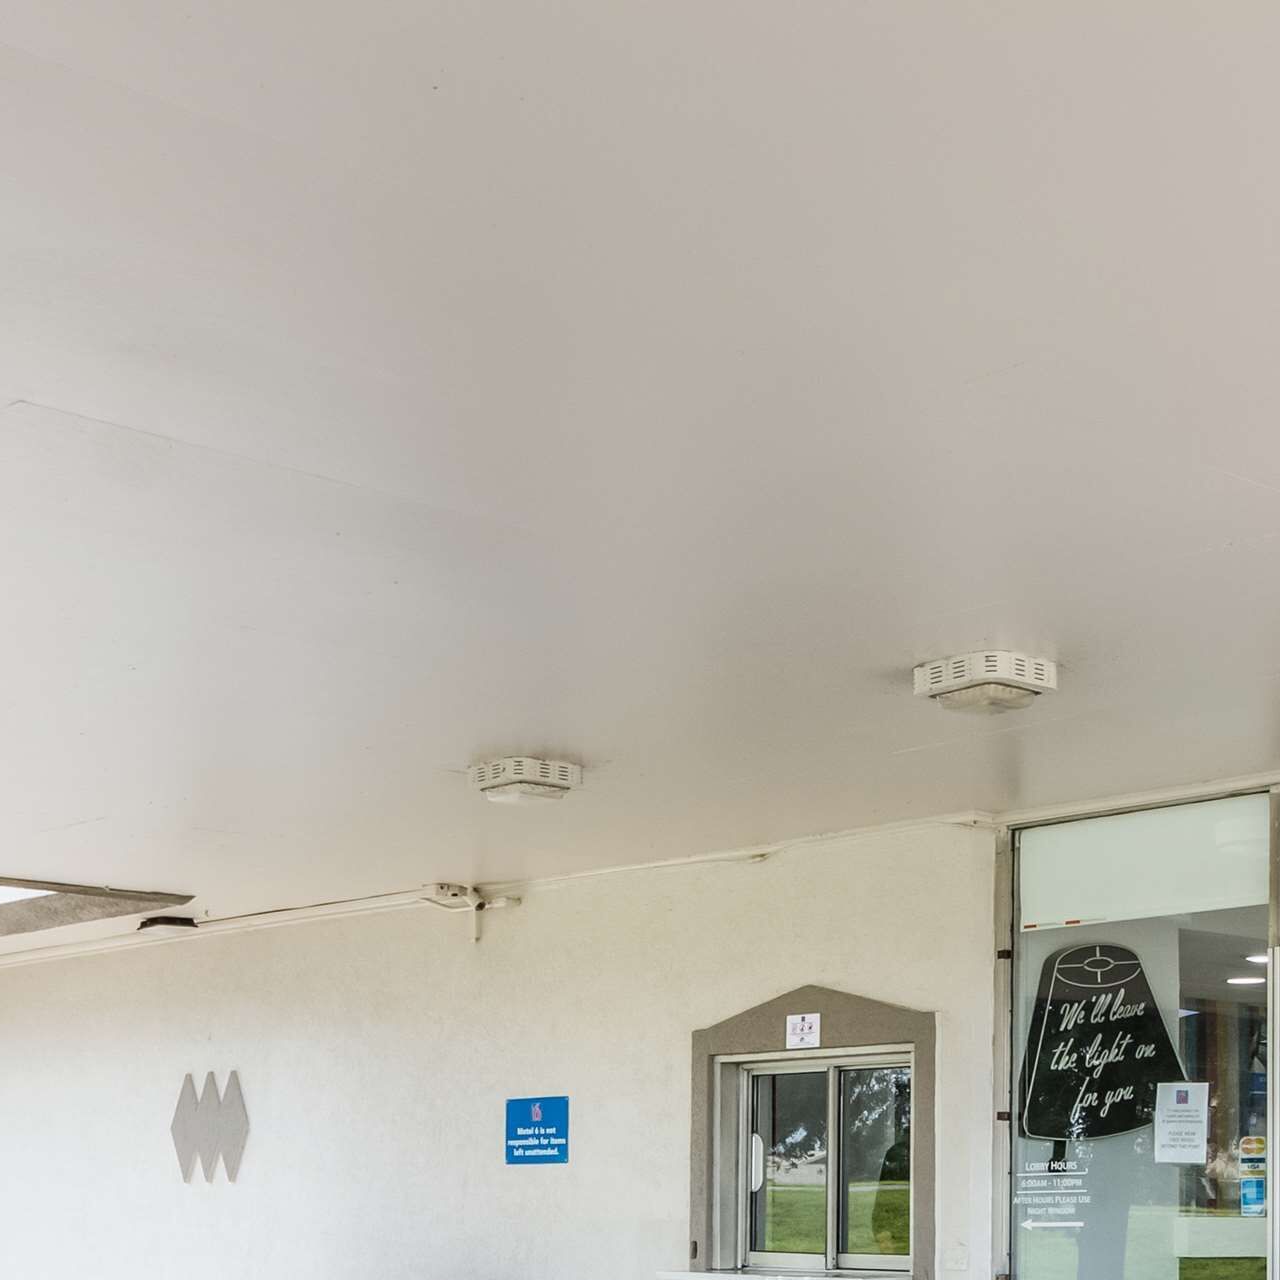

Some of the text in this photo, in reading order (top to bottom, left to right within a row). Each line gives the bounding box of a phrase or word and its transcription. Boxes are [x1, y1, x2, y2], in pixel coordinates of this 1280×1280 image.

[1060, 988, 1145, 1031] We'll leave
[1050, 1031, 1156, 1079] the light on
[1070, 1076, 1134, 1124] for you
[513, 1148, 524, 1156] left
[540, 1136, 549, 1144] for
[550, 1136, 566, 1144] items
[1050, 1160, 1078, 1170] HOURS
